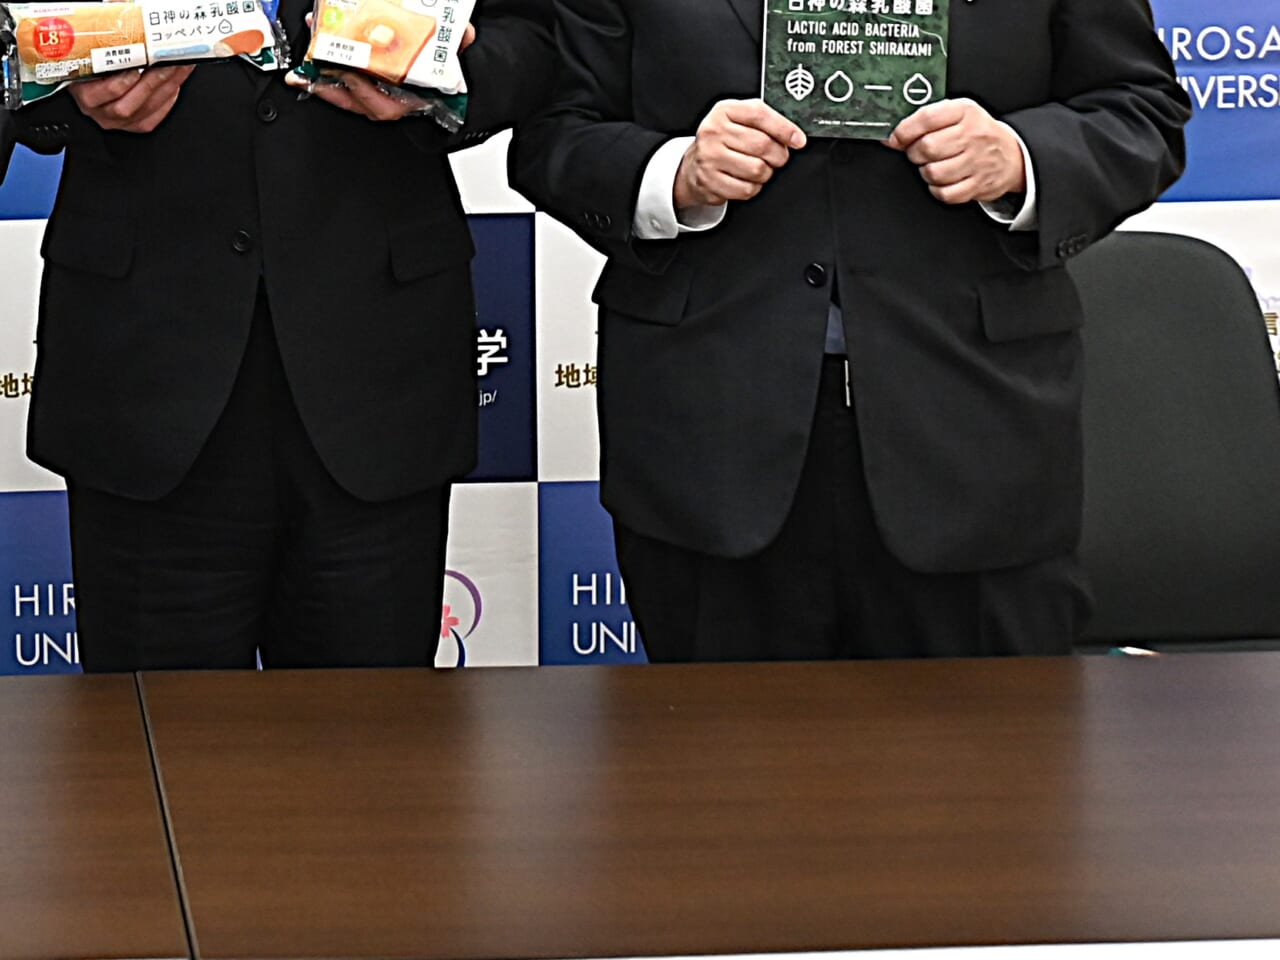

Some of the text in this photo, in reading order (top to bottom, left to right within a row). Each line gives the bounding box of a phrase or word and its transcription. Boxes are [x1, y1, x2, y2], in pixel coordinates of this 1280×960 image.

[787, 20, 920, 38] LACTIC ACID BACTERIA
[787, 38, 932, 57] from FOREST SHIRAKAMI
